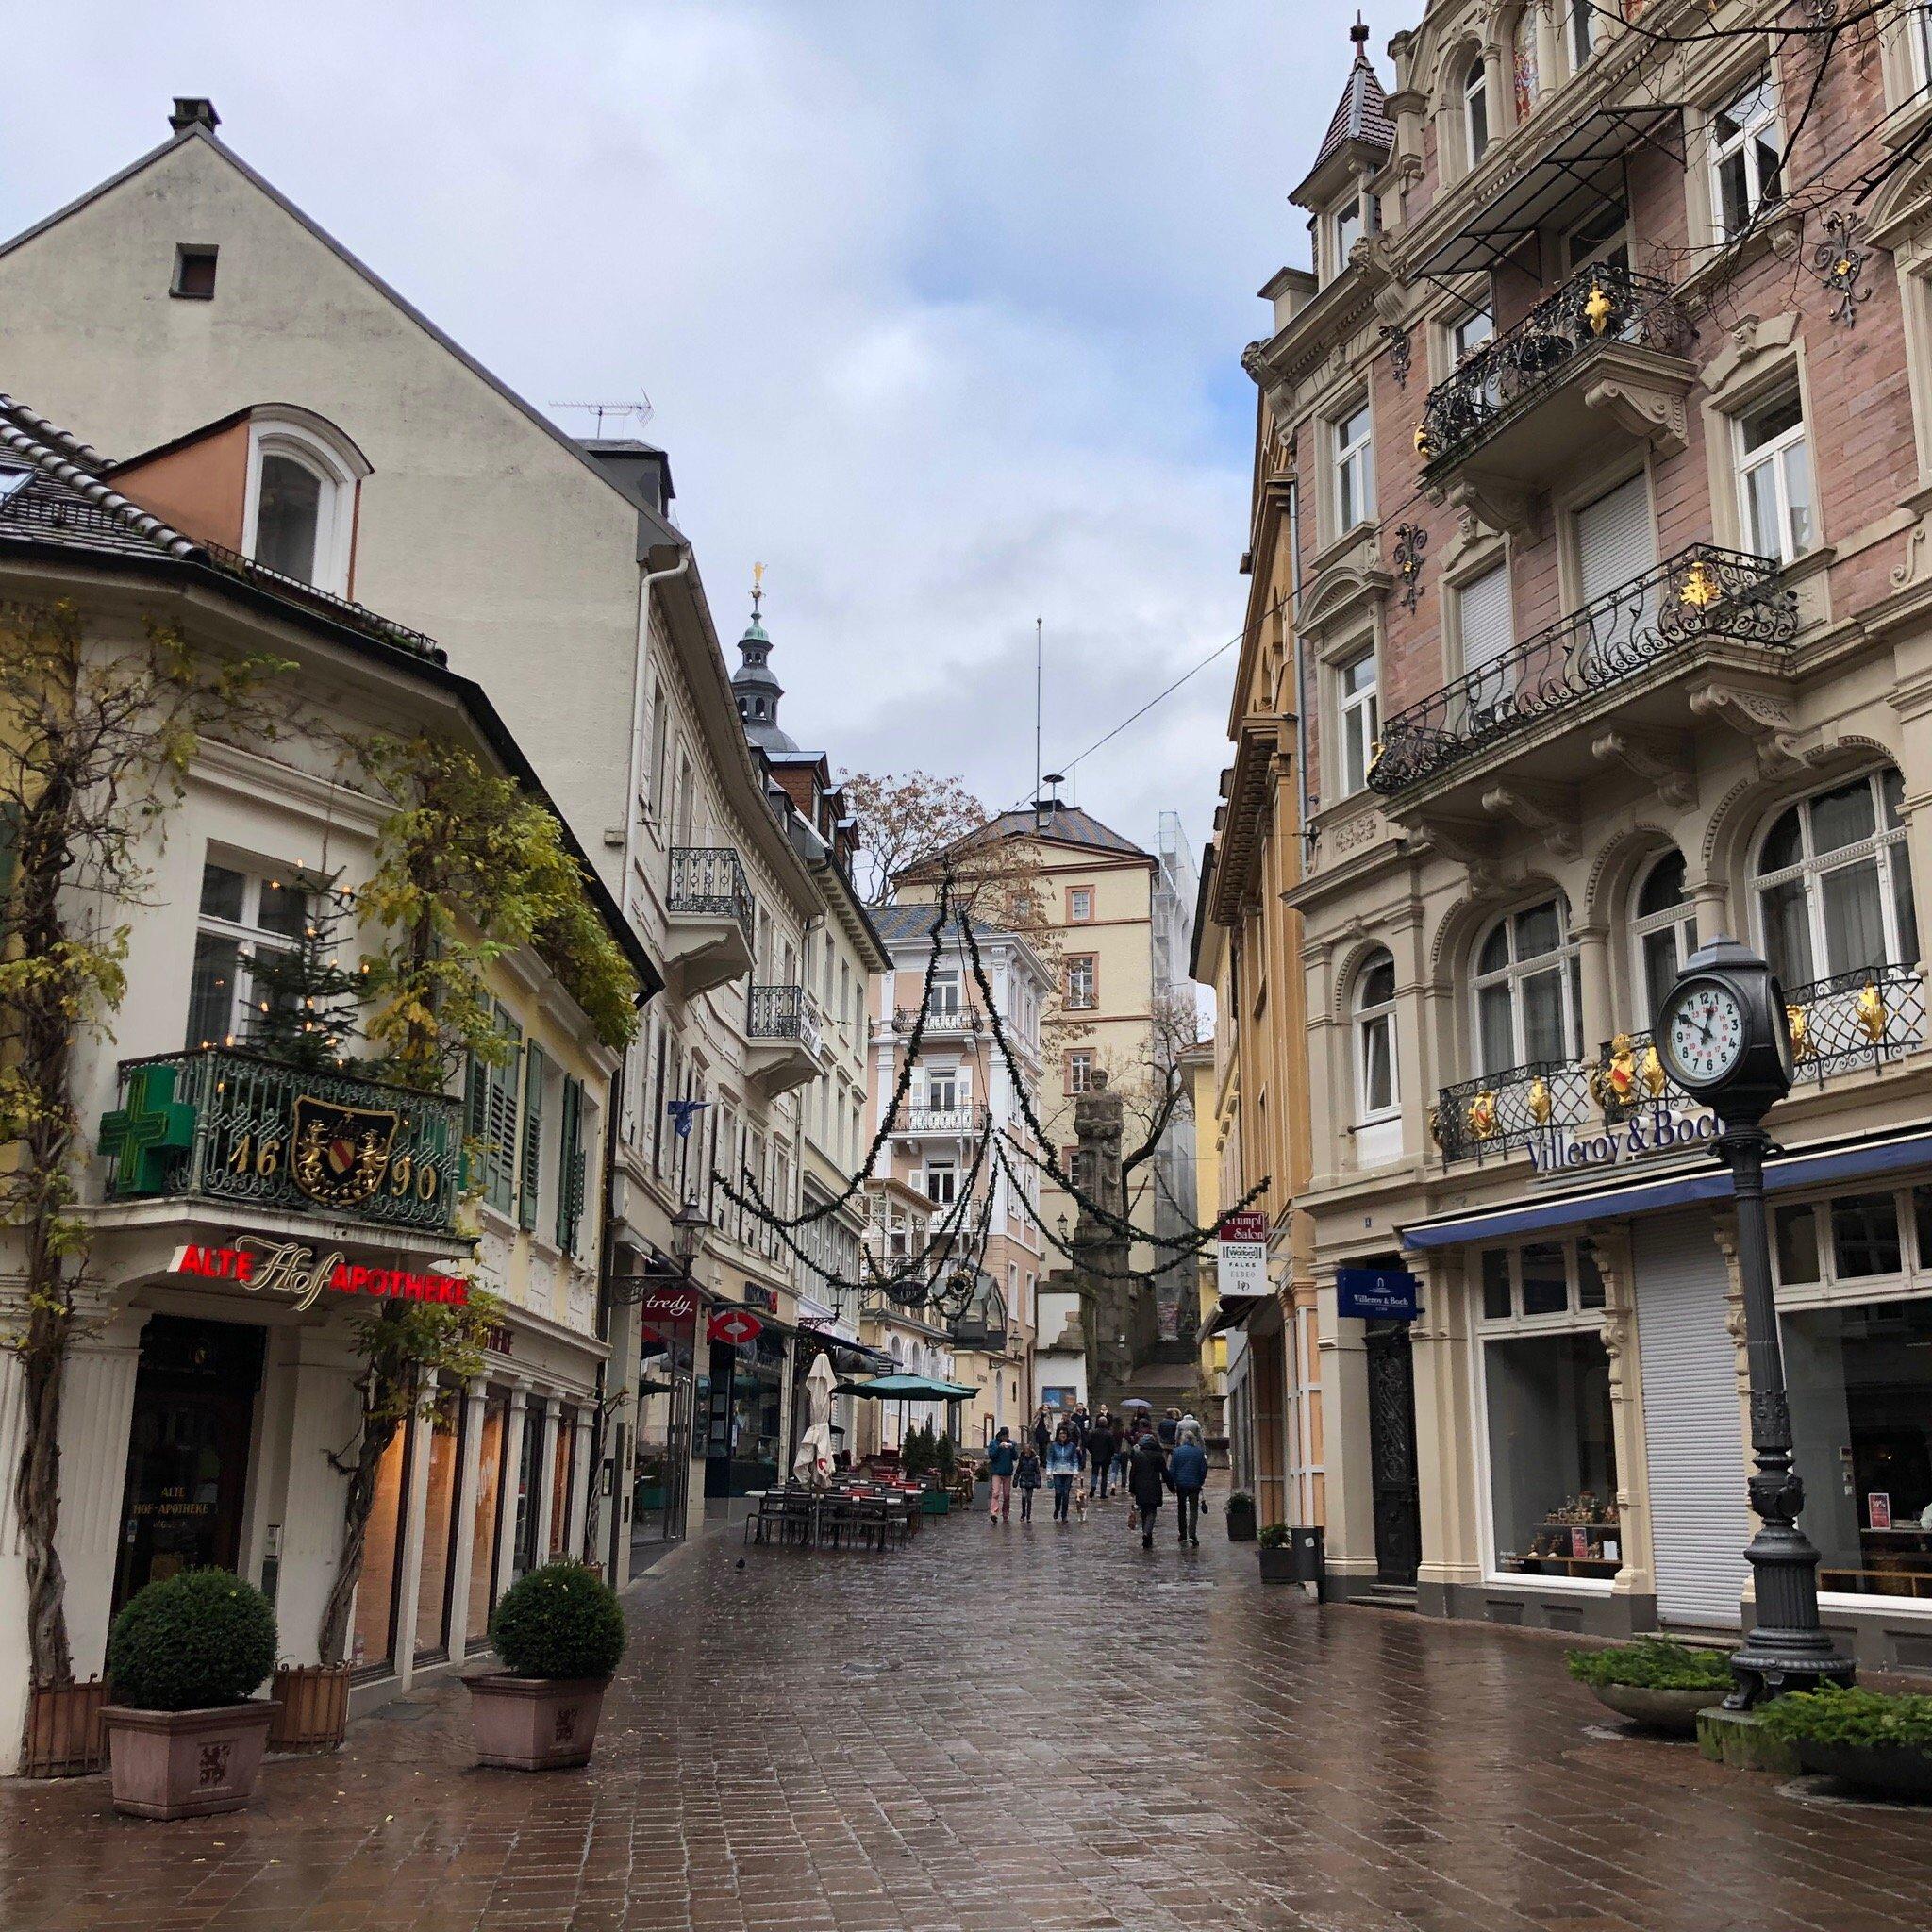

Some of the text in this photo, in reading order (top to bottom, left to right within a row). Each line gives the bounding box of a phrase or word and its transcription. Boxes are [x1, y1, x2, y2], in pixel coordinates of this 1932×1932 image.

[1699, 992, 1709, 1005] 12
[1714, 993, 1719, 1005] 1
[1687, 1000, 1694, 1011] 11
[1726, 1003, 1733, 1015] 2
[1731, 1019, 1739, 1031] 3
[1676, 1031, 1683, 1043] 9
[1728, 1038, 1737, 1049] 4
[1682, 1046, 1689, 1058] 8
[1720, 1052, 1727, 1063] 5
[1692, 1058, 1699, 1070] 7
[1707, 1059, 1713, 1071] 6
[1526, 1128, 1623, 1172] Villeroy
[1626, 1115, 1650, 1153] &
[228, 1134, 437, 1201] 16 90
[1233, 1227, 1264, 1240] Salon
[178, 1234, 470, 1312] ALTE Hof APOTHEKE
[1354, 1293, 1408, 1306] Villeroy & Boch
[161, 1486, 186, 1498] ALTE
